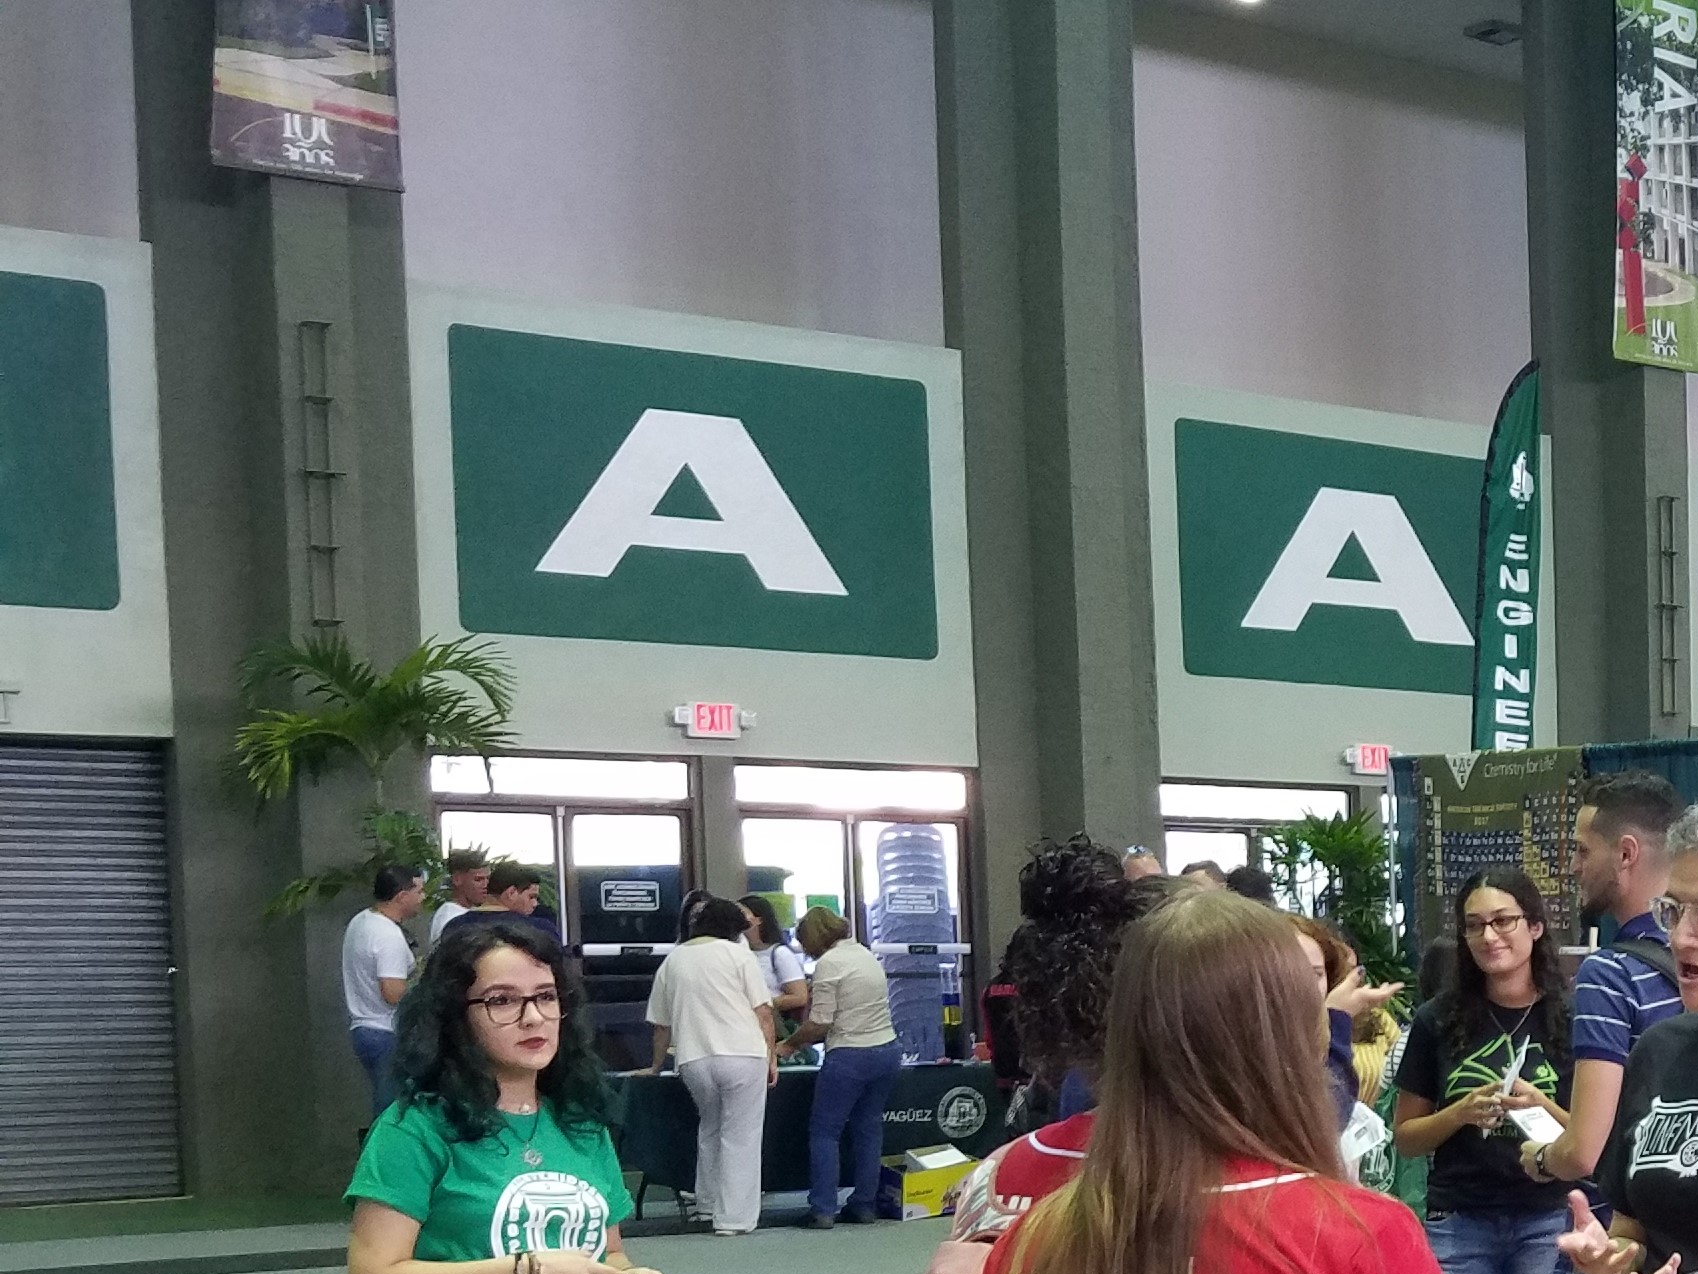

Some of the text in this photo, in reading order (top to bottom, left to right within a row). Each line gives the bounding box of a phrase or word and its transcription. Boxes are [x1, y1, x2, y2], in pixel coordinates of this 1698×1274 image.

[535, 408, 849, 596] A
[1241, 485, 1475, 646] A
[696, 704, 733, 732] EXIT
